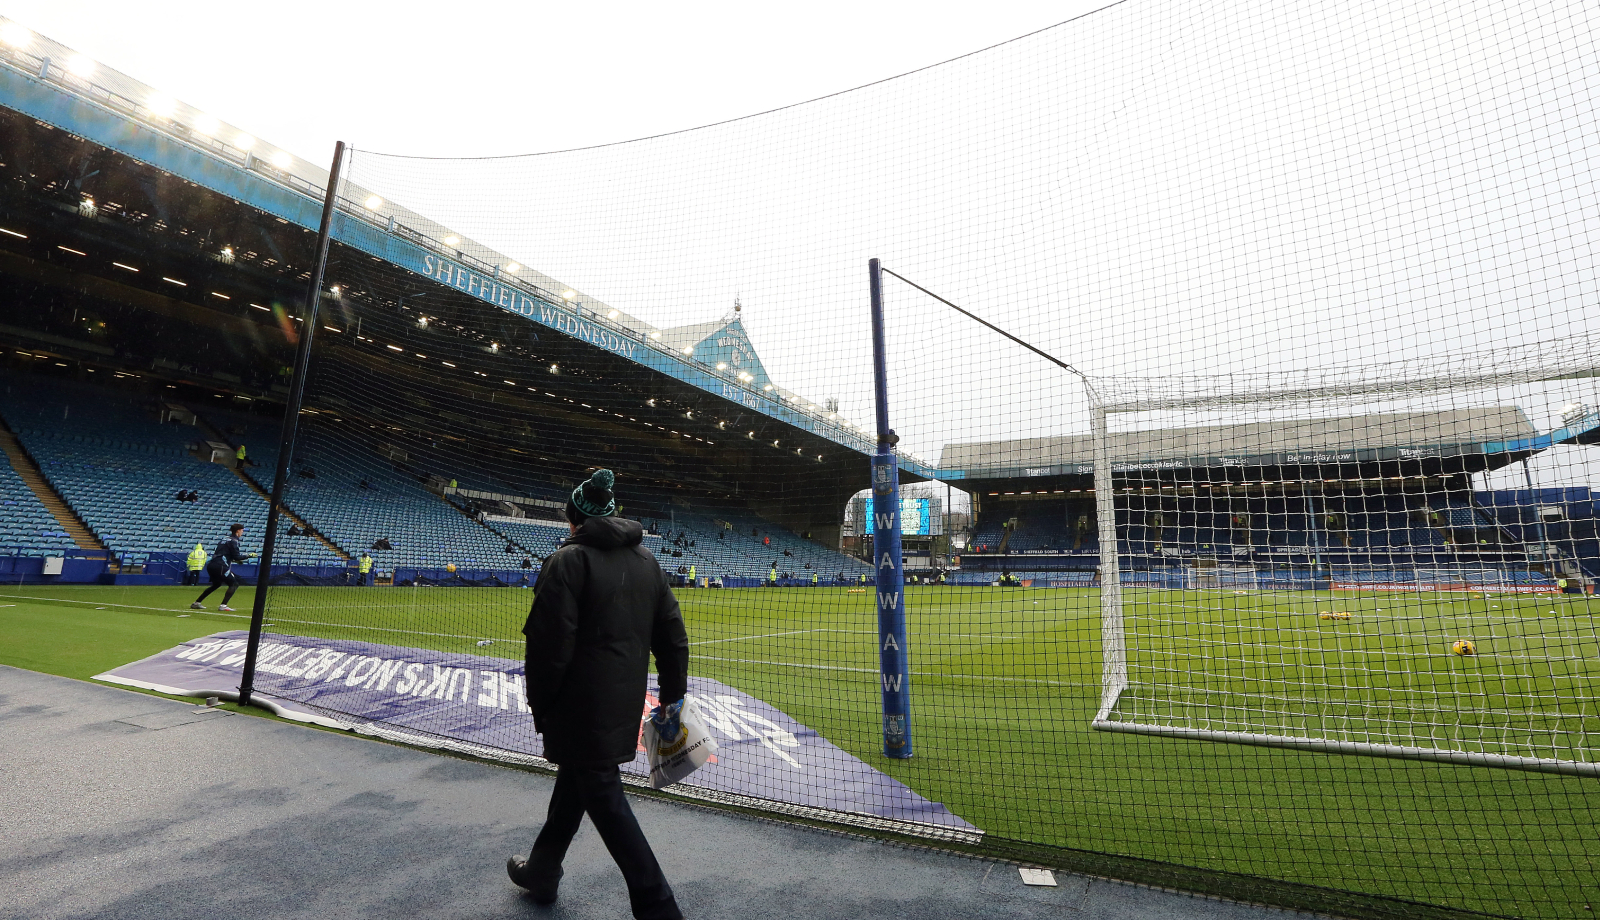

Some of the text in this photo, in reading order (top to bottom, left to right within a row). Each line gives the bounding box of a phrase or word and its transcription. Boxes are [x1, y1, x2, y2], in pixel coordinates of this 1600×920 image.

[422, 255, 637, 358] SHEFFIELD WEDNESDAY
[723, 383, 761, 410] EST. 1867
[1333, 452, 1351, 460] now
[396, 662, 472, 703] UK'S
[477, 670, 533, 714] HE
[702, 736, 711, 744] FC
